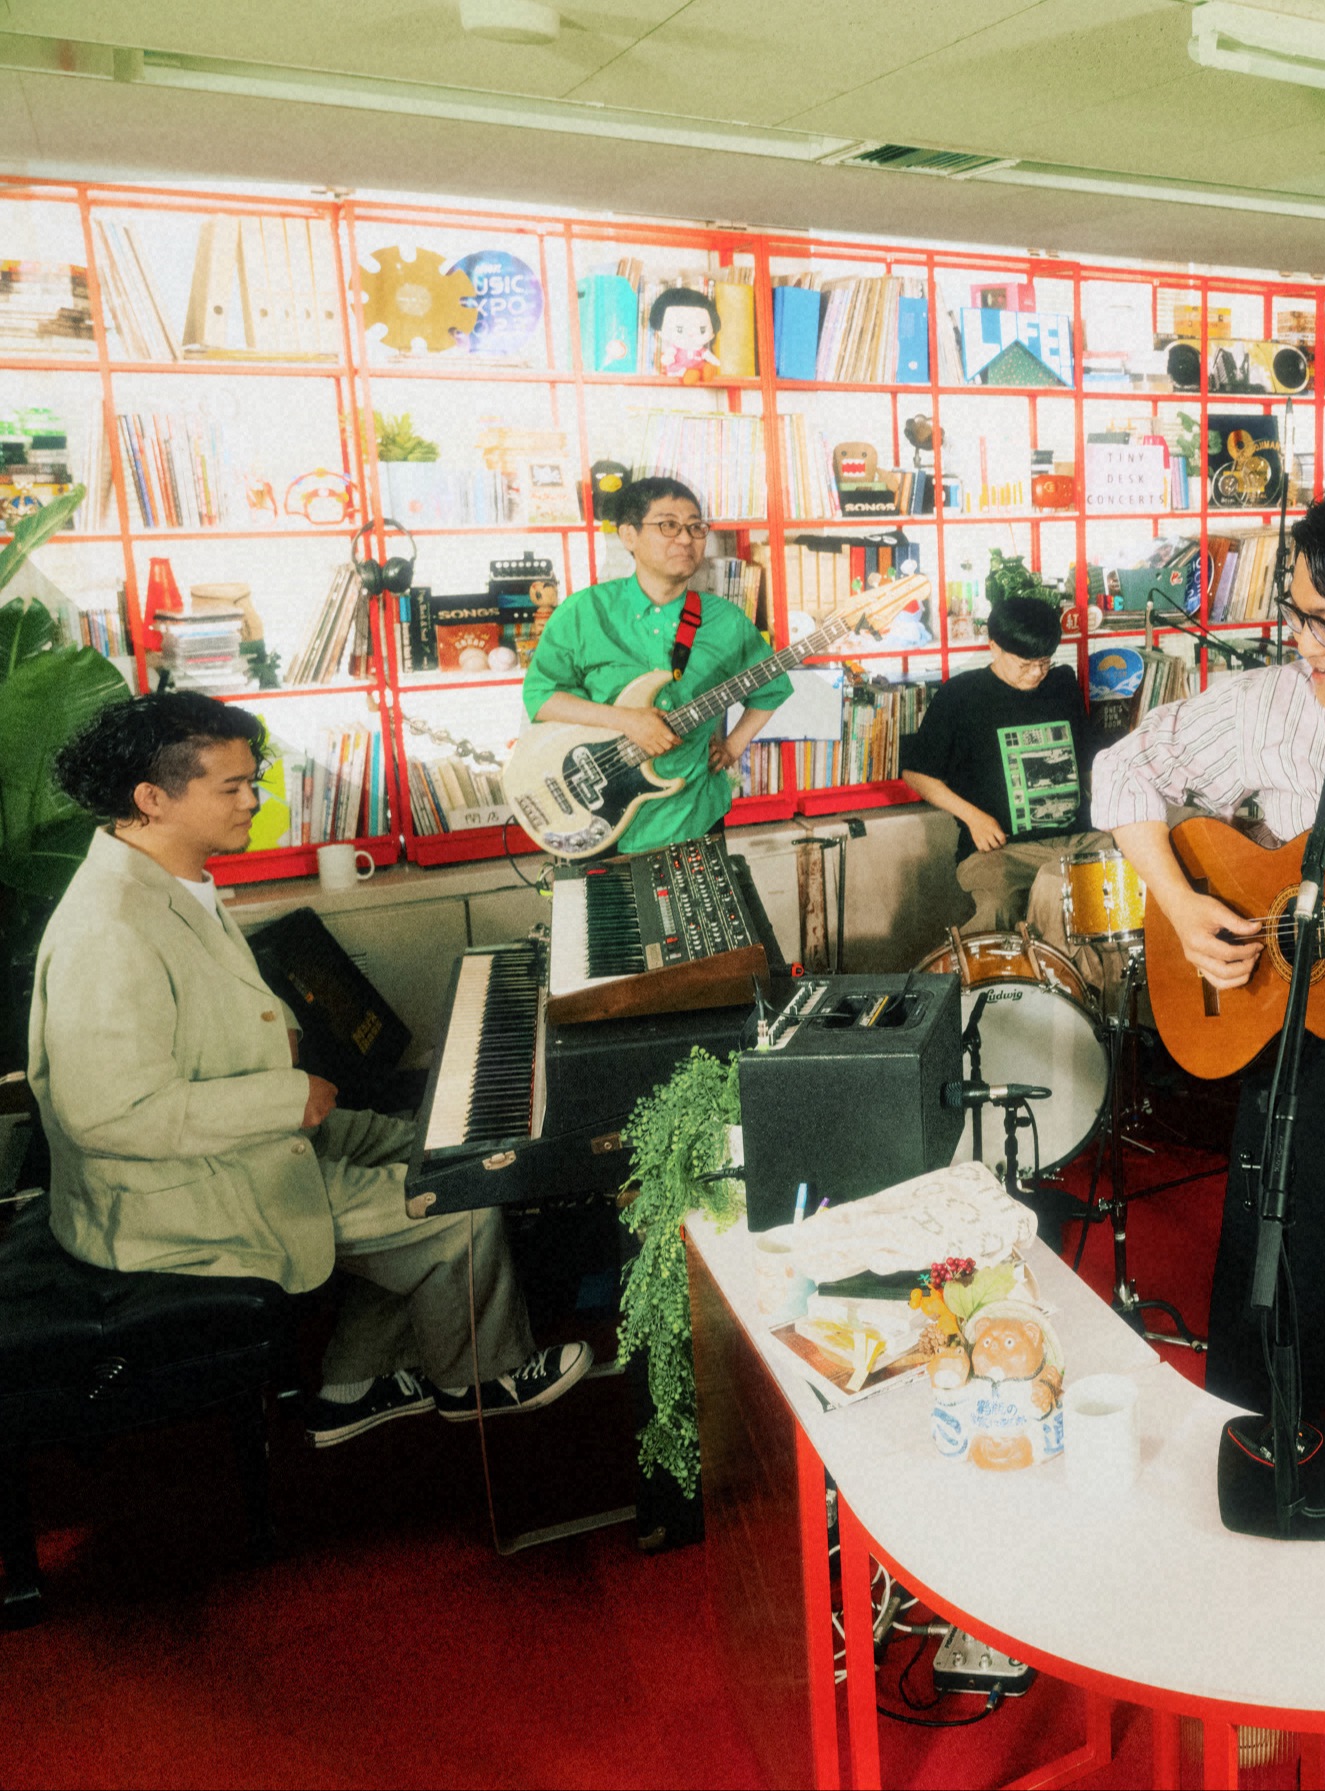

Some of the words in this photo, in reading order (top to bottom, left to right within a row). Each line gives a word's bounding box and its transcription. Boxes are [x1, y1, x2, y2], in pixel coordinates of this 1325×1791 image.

[473, 274, 526, 296] USIC
[475, 296, 527, 317] XPO
[1107, 452, 1145, 464] TINY
[1107, 473, 1145, 484] DESK
[1086, 494, 1166, 506] CONCERTS
[844, 502, 897, 513] SONGS
[437, 607, 501, 620] SONGS
[986, 988, 1024, 1004] Ludwig
